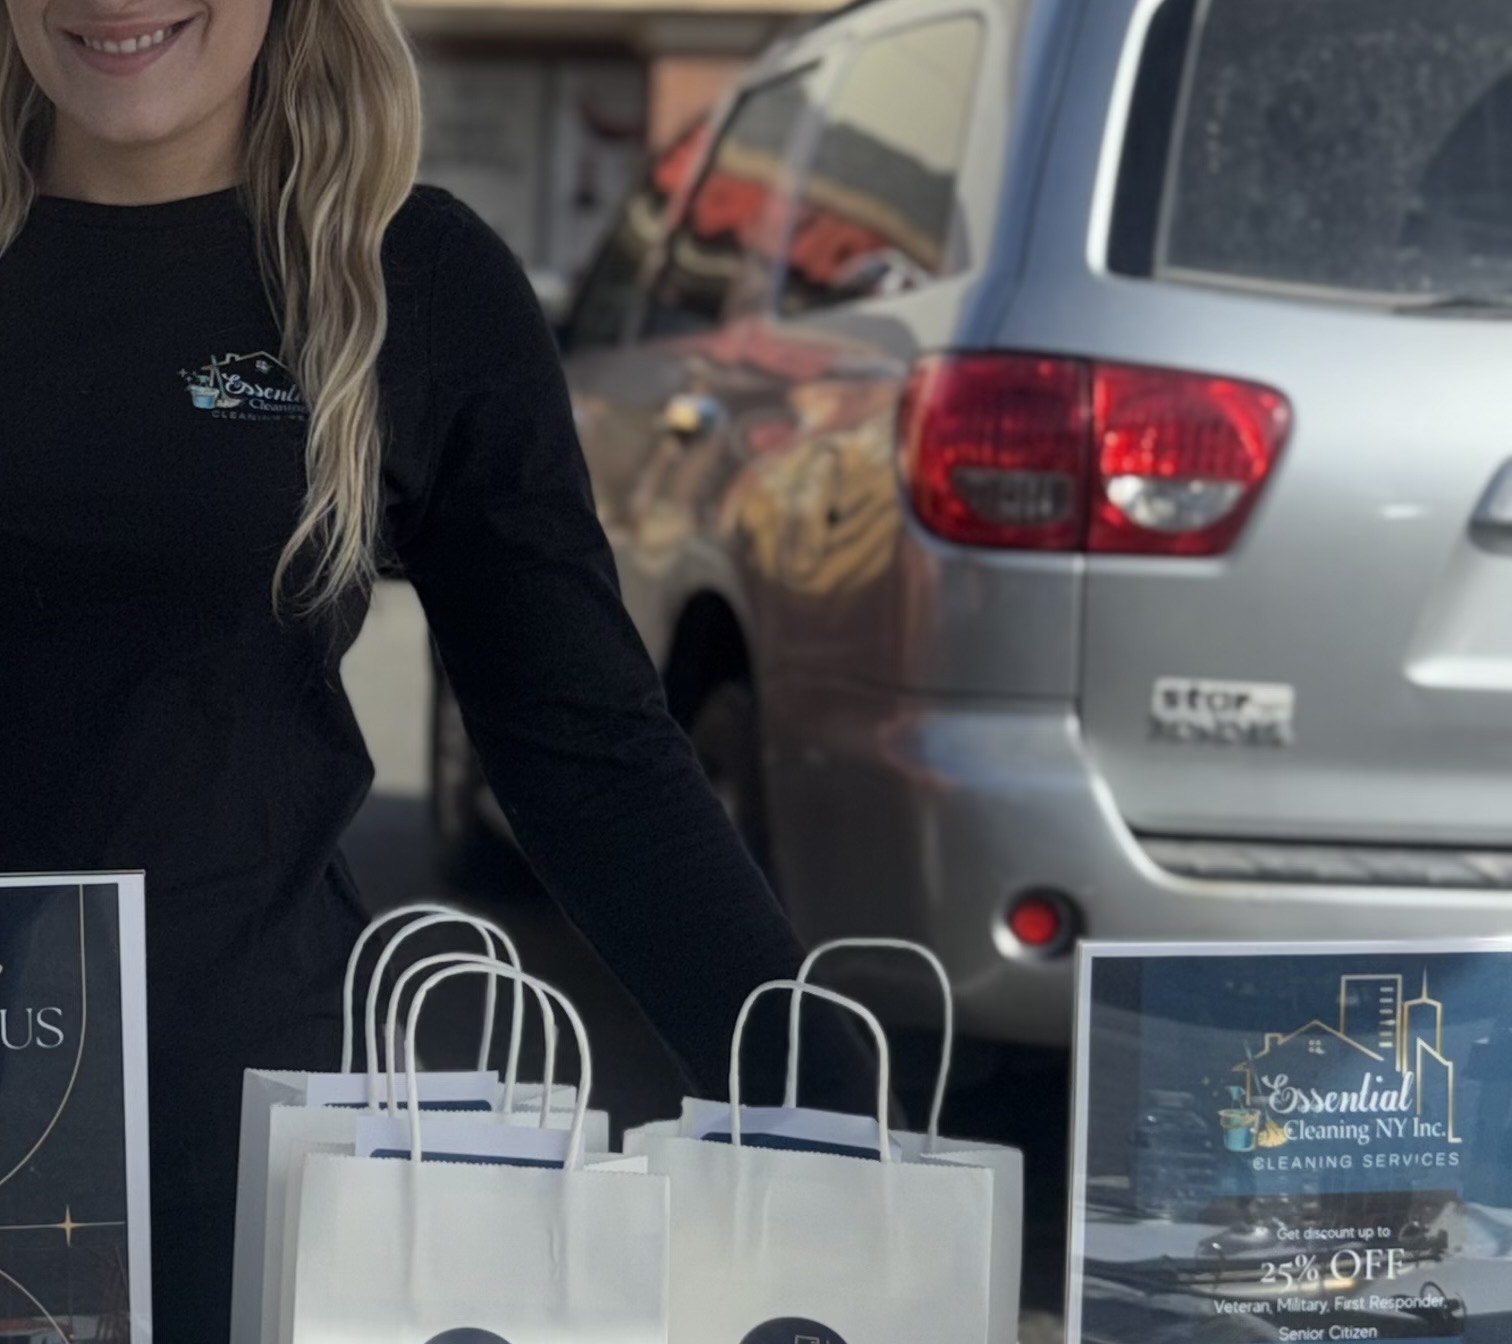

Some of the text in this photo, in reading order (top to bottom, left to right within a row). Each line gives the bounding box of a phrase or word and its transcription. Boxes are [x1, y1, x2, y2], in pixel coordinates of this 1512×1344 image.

[0, 1006, 64, 1050] US
[1261, 1070, 1414, 1114] Essential
[1284, 1117, 1446, 1145] Cleaning NY Inc.
[1252, 1152, 1459, 1171] CLEANING SERVICES
[1276, 1226, 1391, 1241] Get discount up to
[1260, 1248, 1405, 1290] 25% OFF
[1334, 1296, 1366, 1311] First
[1278, 1325, 1377, 1341] Senior Citizen
